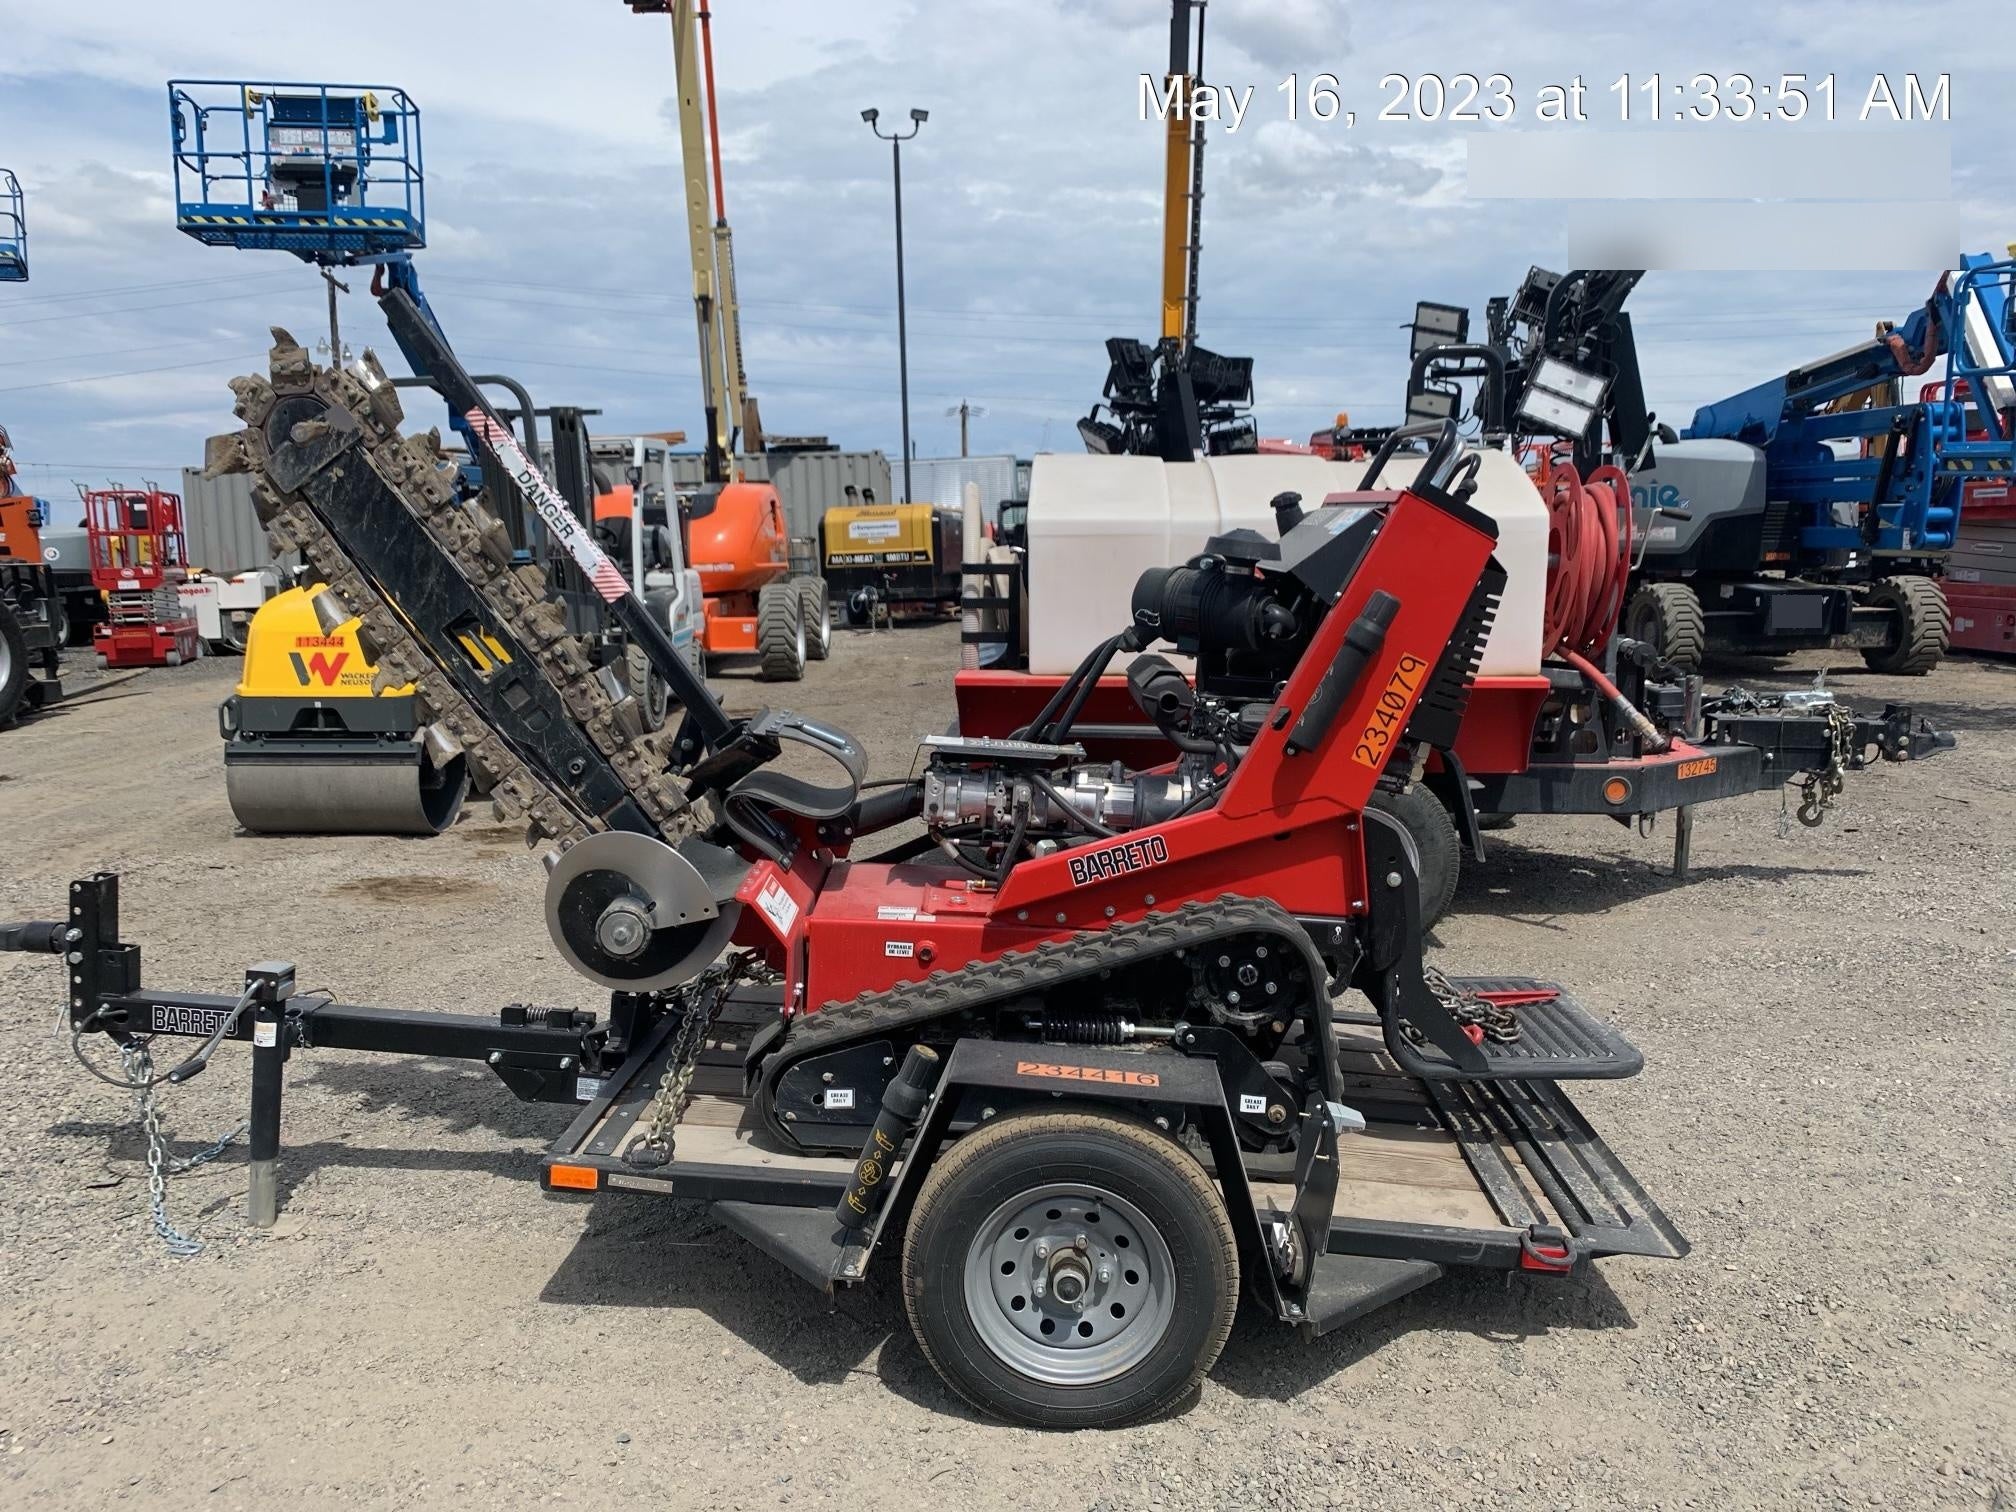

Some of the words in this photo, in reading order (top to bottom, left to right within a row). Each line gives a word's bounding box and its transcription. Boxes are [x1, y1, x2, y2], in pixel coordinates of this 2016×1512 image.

[517, 470, 575, 540] DANGER
[297, 636, 344, 647] 113444
[1355, 656, 1426, 766] 234079
[1679, 757, 1716, 778] 132745
[1068, 834, 1170, 887] BARRETO
[152, 1005, 239, 1037] BARRETO
[1021, 1063, 1156, 1085] 234416
